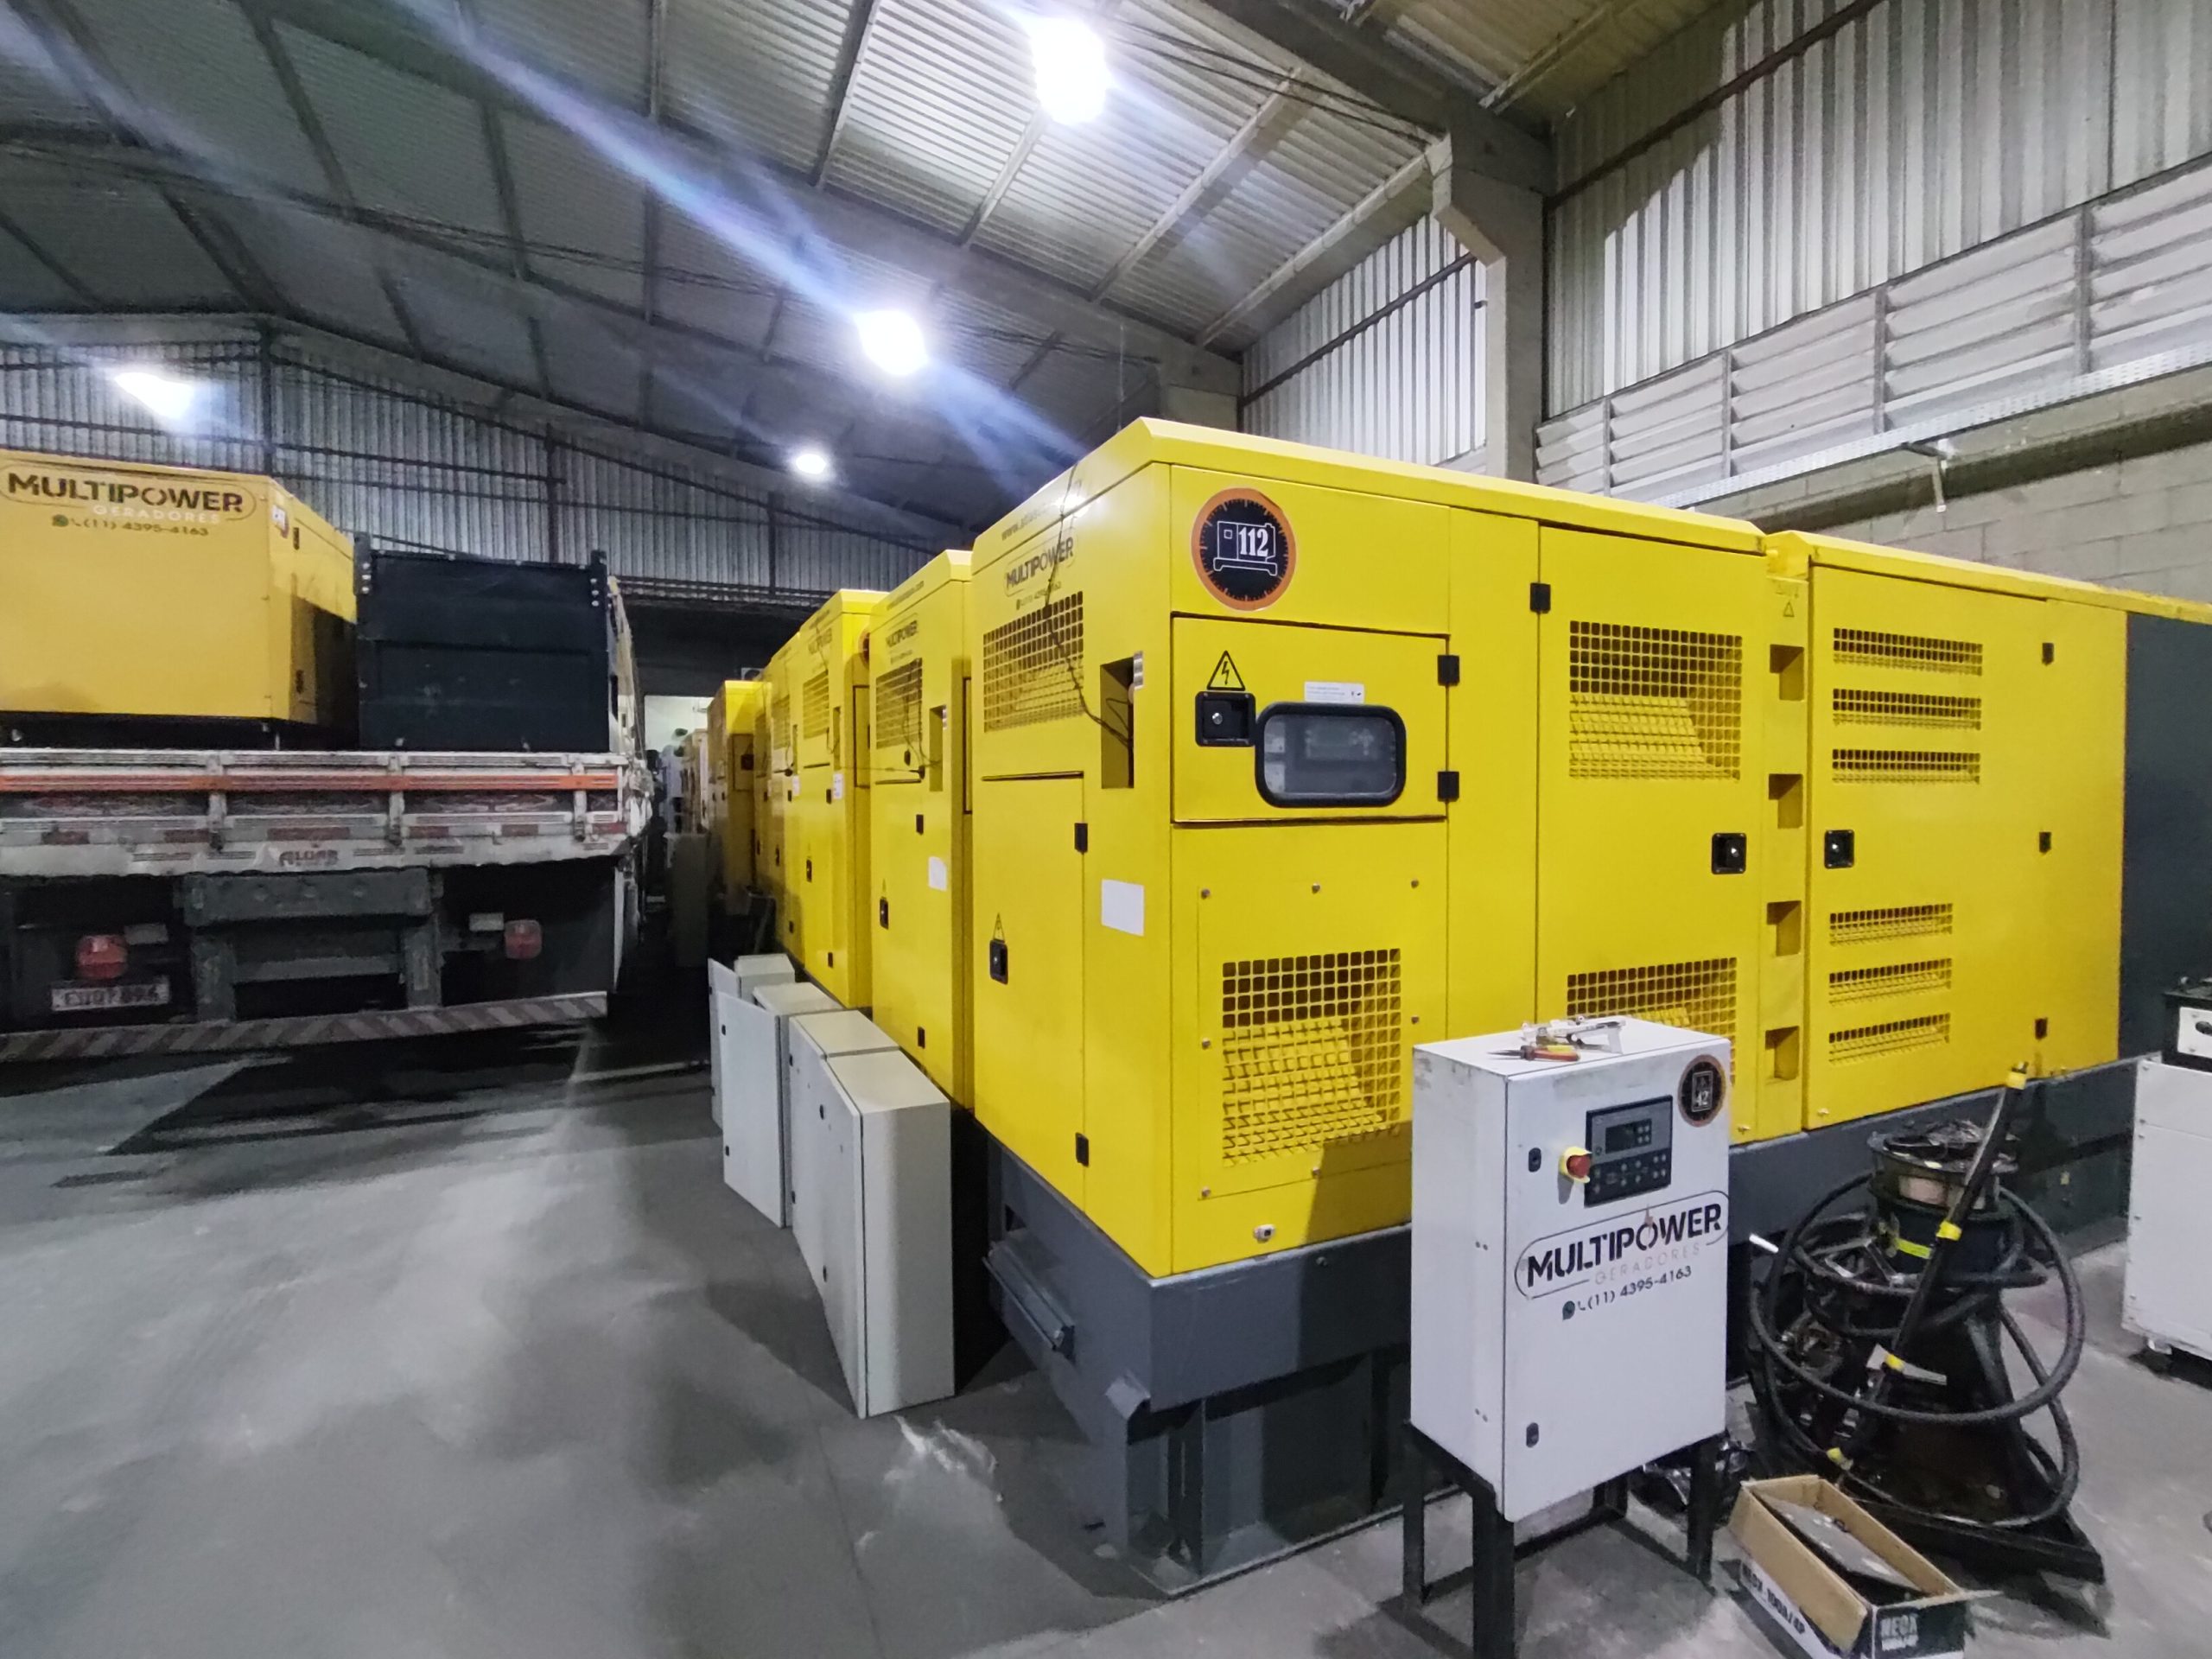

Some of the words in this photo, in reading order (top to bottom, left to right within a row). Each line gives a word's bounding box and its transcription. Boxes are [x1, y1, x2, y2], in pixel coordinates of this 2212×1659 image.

[8, 472, 244, 513] MULTIPOWER
[92, 503, 221, 525] GERADORES
[123, 520, 210, 537] 4395-4163
[1237, 527, 1269, 557] 112
[1695, 1090, 1709, 1107] 42
[1527, 1202, 1722, 1287] MULTIPOWER
[1587, 1289, 1616, 1310] (11)
[1620, 1265, 1693, 1296] 4395-4163
